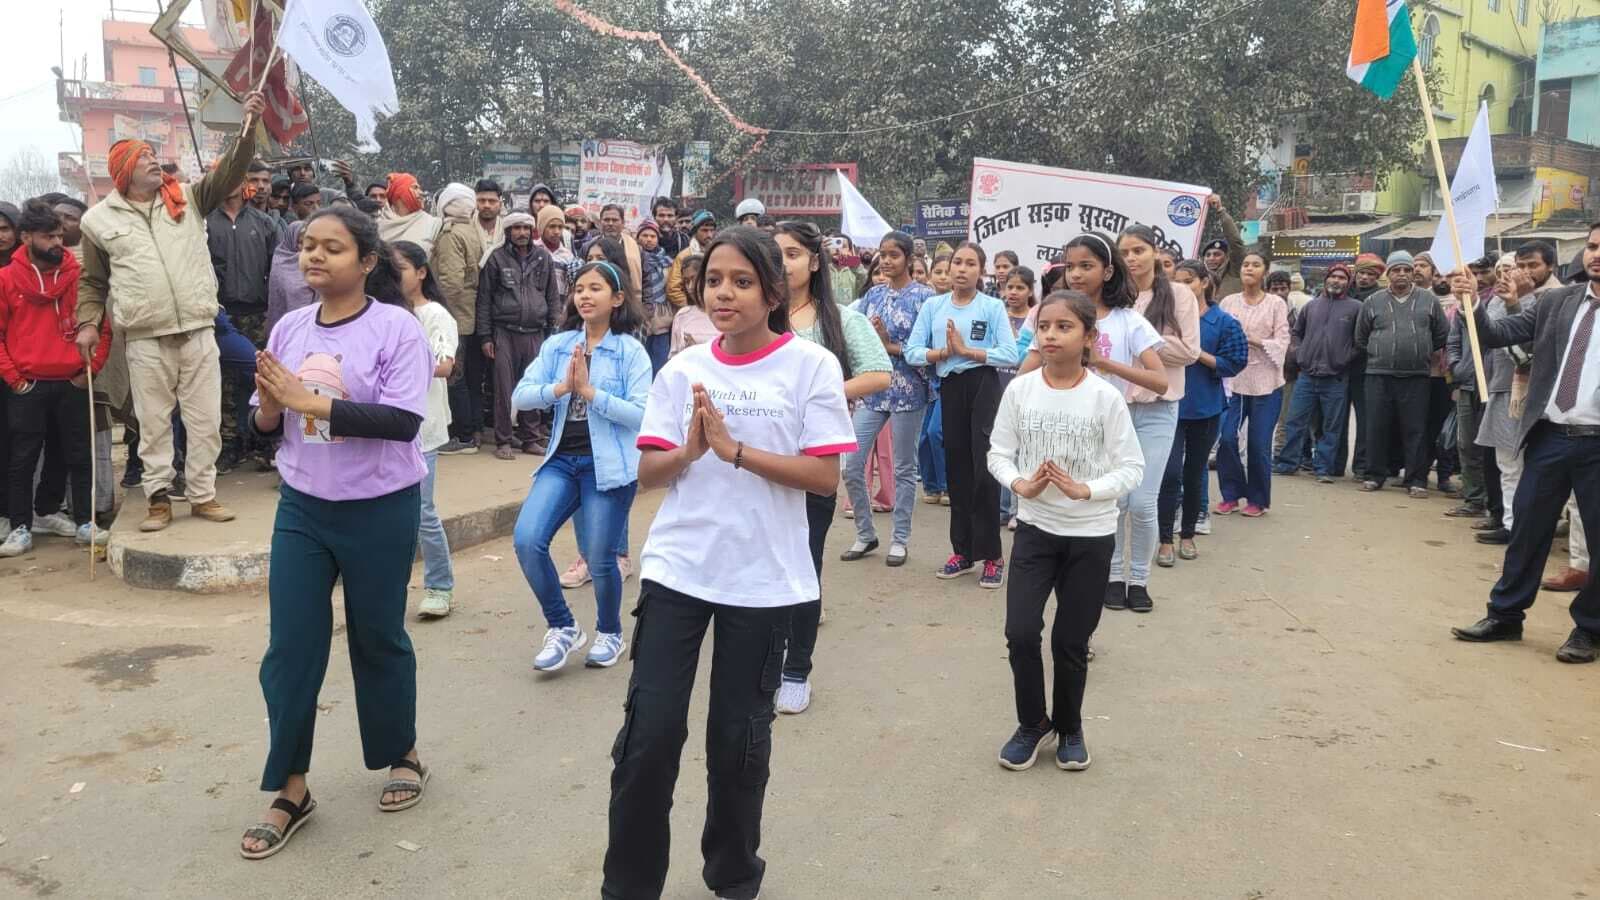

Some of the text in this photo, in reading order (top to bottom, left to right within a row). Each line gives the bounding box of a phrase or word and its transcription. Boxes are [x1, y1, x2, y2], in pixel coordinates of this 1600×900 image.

[921, 204, 956, 218] सैनिक
[973, 203, 1130, 243] जिला सड़क सुरक्षा
[1294, 239, 1336, 247] reame
[709, 389, 756, 401] With All
[726, 404, 784, 417] Reserves
